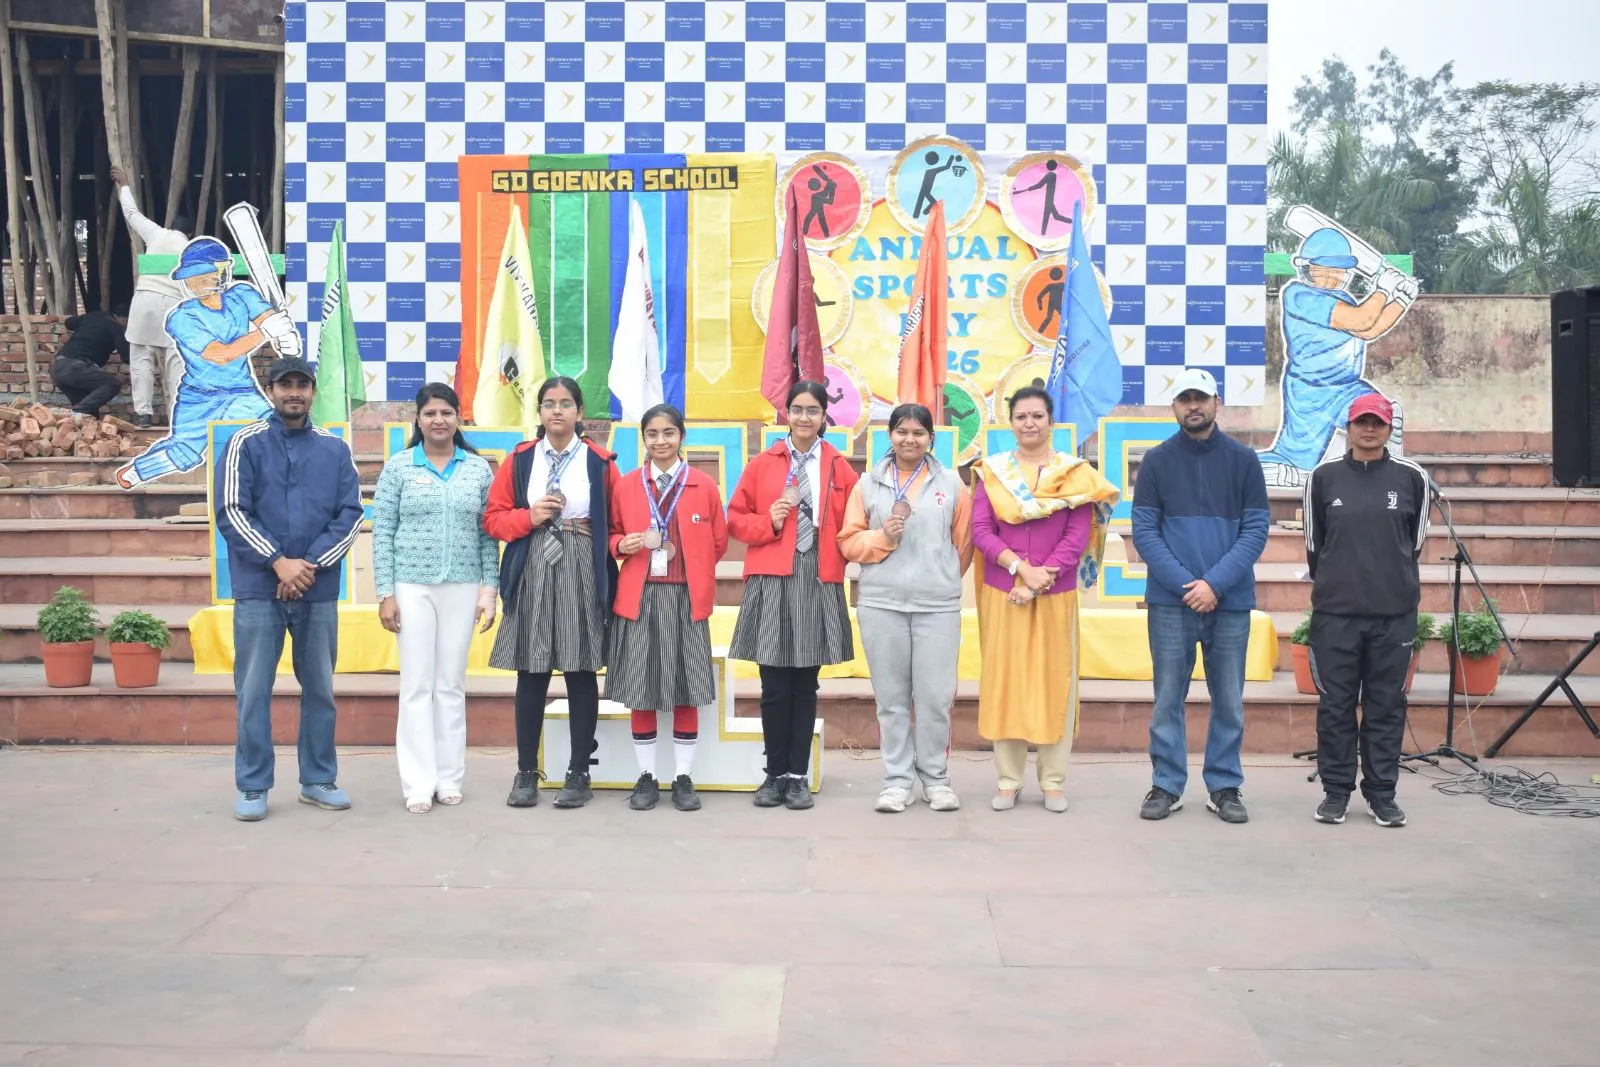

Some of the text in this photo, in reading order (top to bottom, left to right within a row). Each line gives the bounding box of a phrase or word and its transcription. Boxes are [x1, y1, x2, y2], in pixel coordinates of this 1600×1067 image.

[492, 167, 738, 192] GD GOENKA SCHOOL
